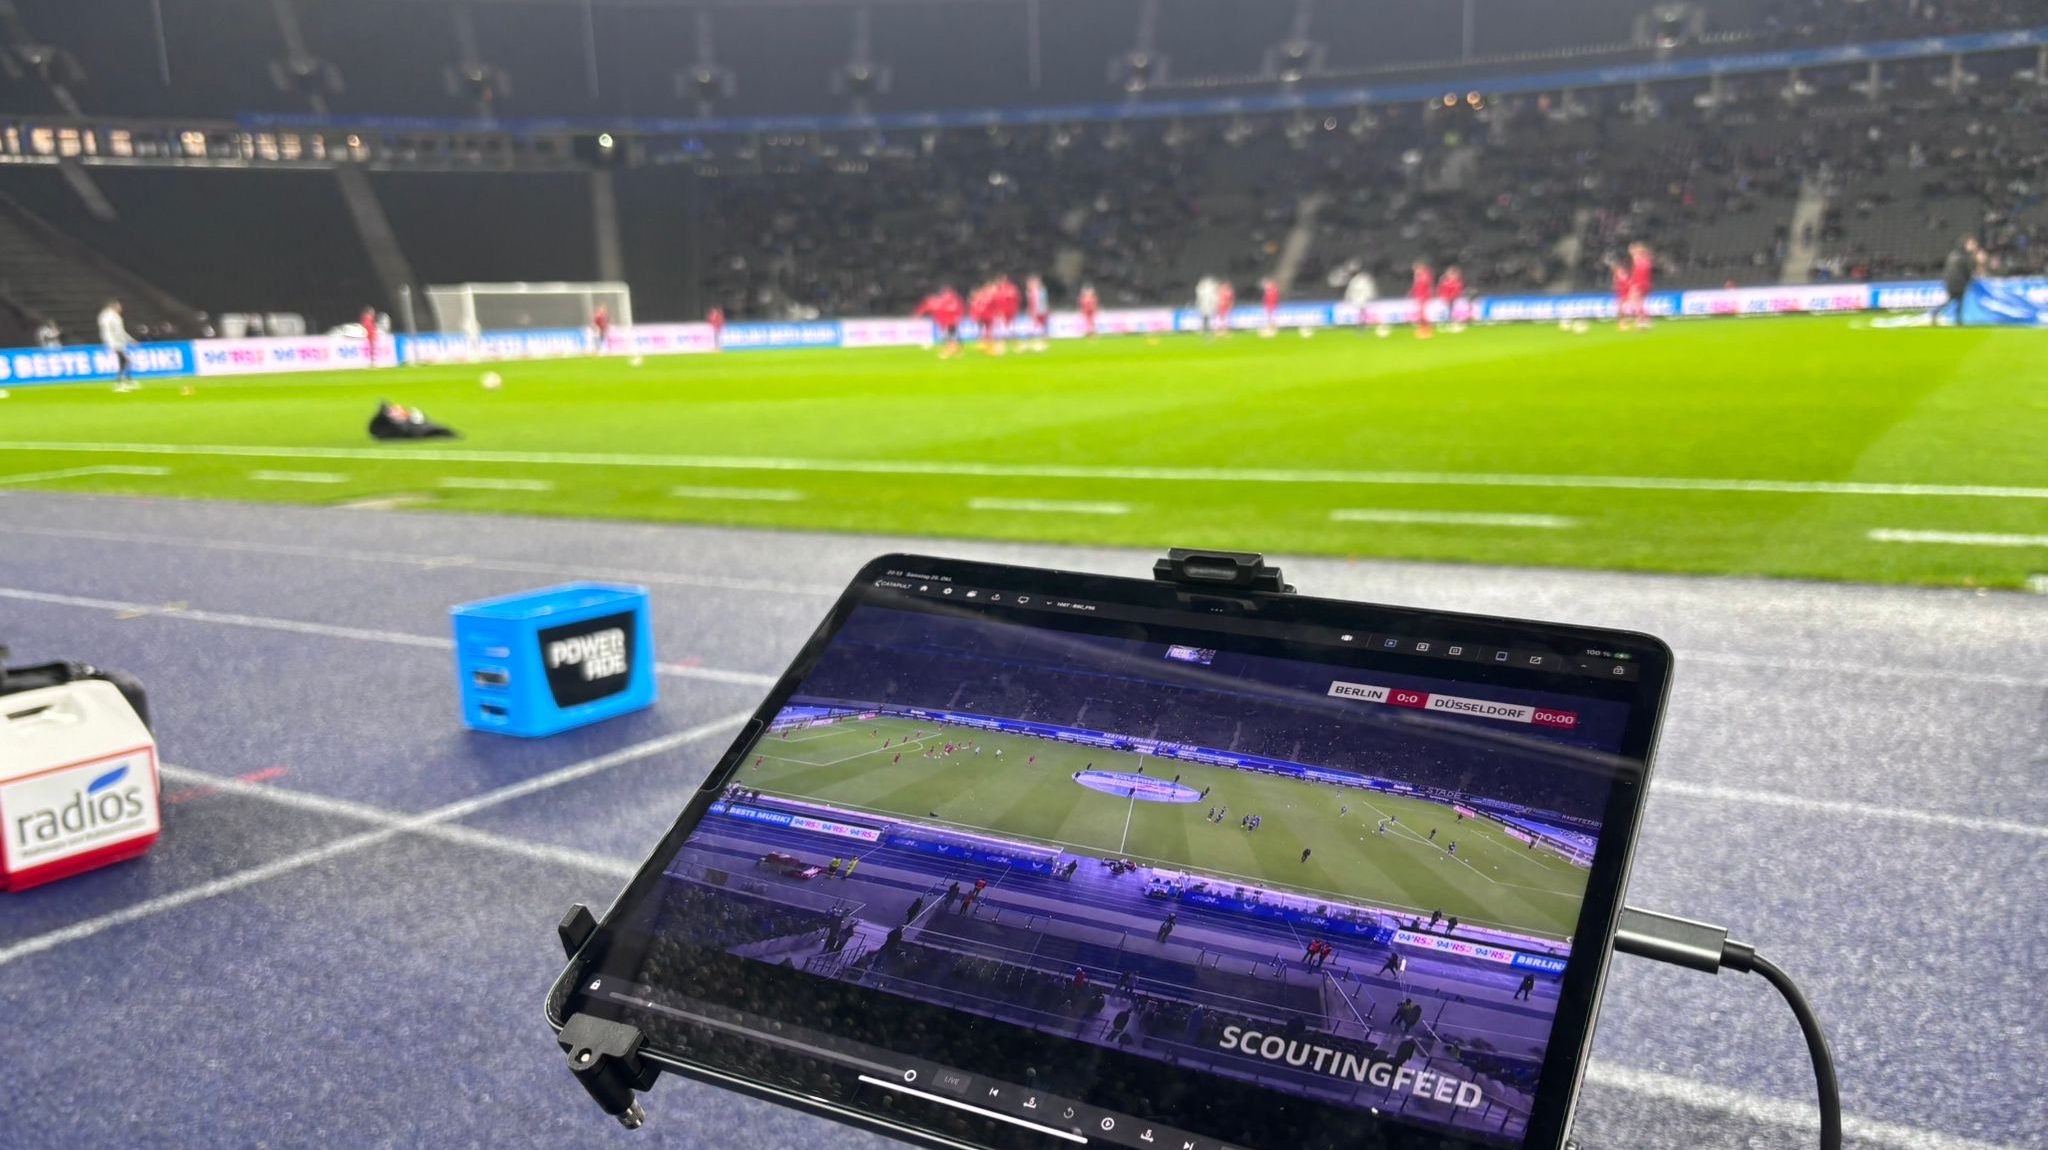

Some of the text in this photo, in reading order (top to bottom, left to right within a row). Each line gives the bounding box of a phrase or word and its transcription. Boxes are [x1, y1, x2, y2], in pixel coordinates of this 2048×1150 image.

[13, 351, 91, 379] BESTE
[93, 347, 183, 374] MSIK!
[549, 627, 625, 668] POWER
[1334, 685, 1575, 725] BERLIN 0:0 DÜSSELDORF 00:00
[17, 784, 144, 845] radios
[730, 806, 756, 817] BESTE
[944, 1075, 960, 1087] LIVE
[1218, 1025, 1483, 1109] SCOUTINGFEED
